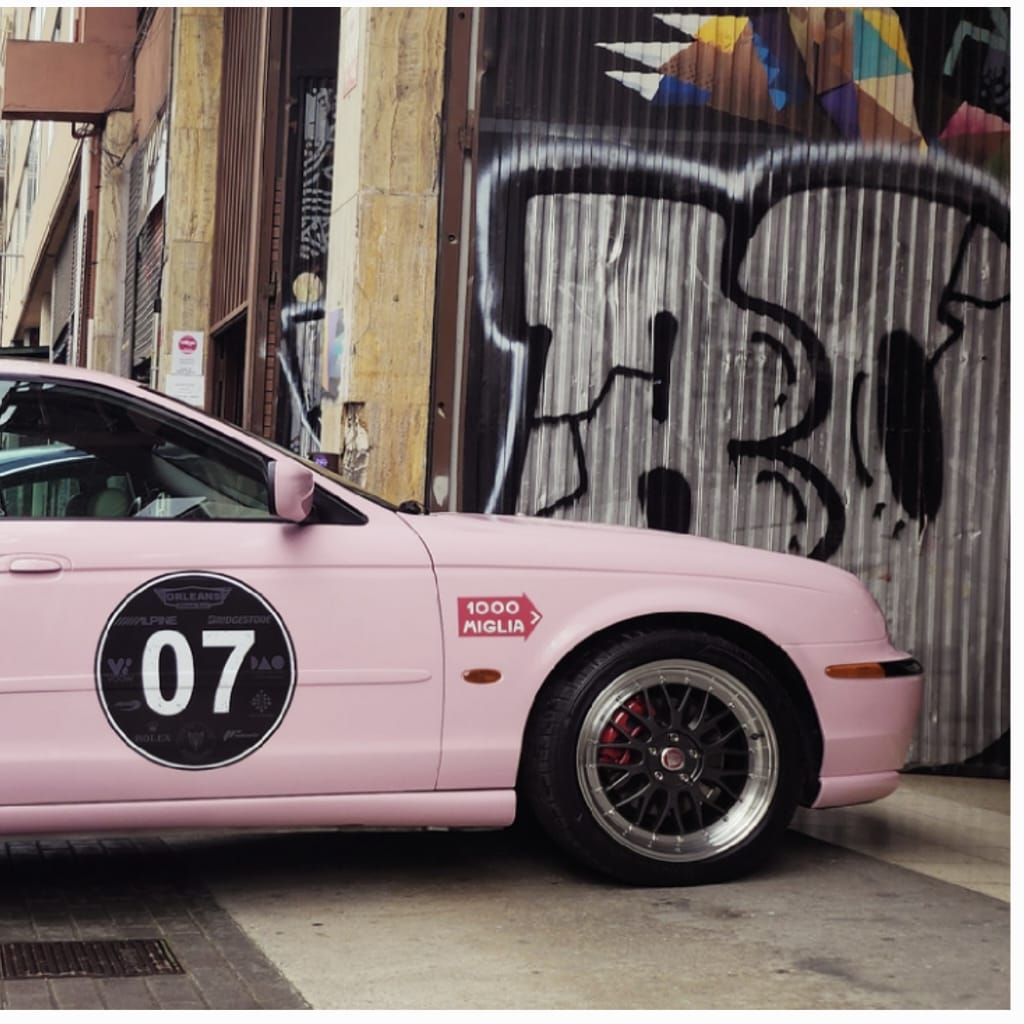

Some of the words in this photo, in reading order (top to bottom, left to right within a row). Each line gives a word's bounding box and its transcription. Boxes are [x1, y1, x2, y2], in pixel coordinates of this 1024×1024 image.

[466, 600, 520, 615] 1000
[463, 619, 525, 634] MIGLIA
[141, 629, 256, 716] 07
